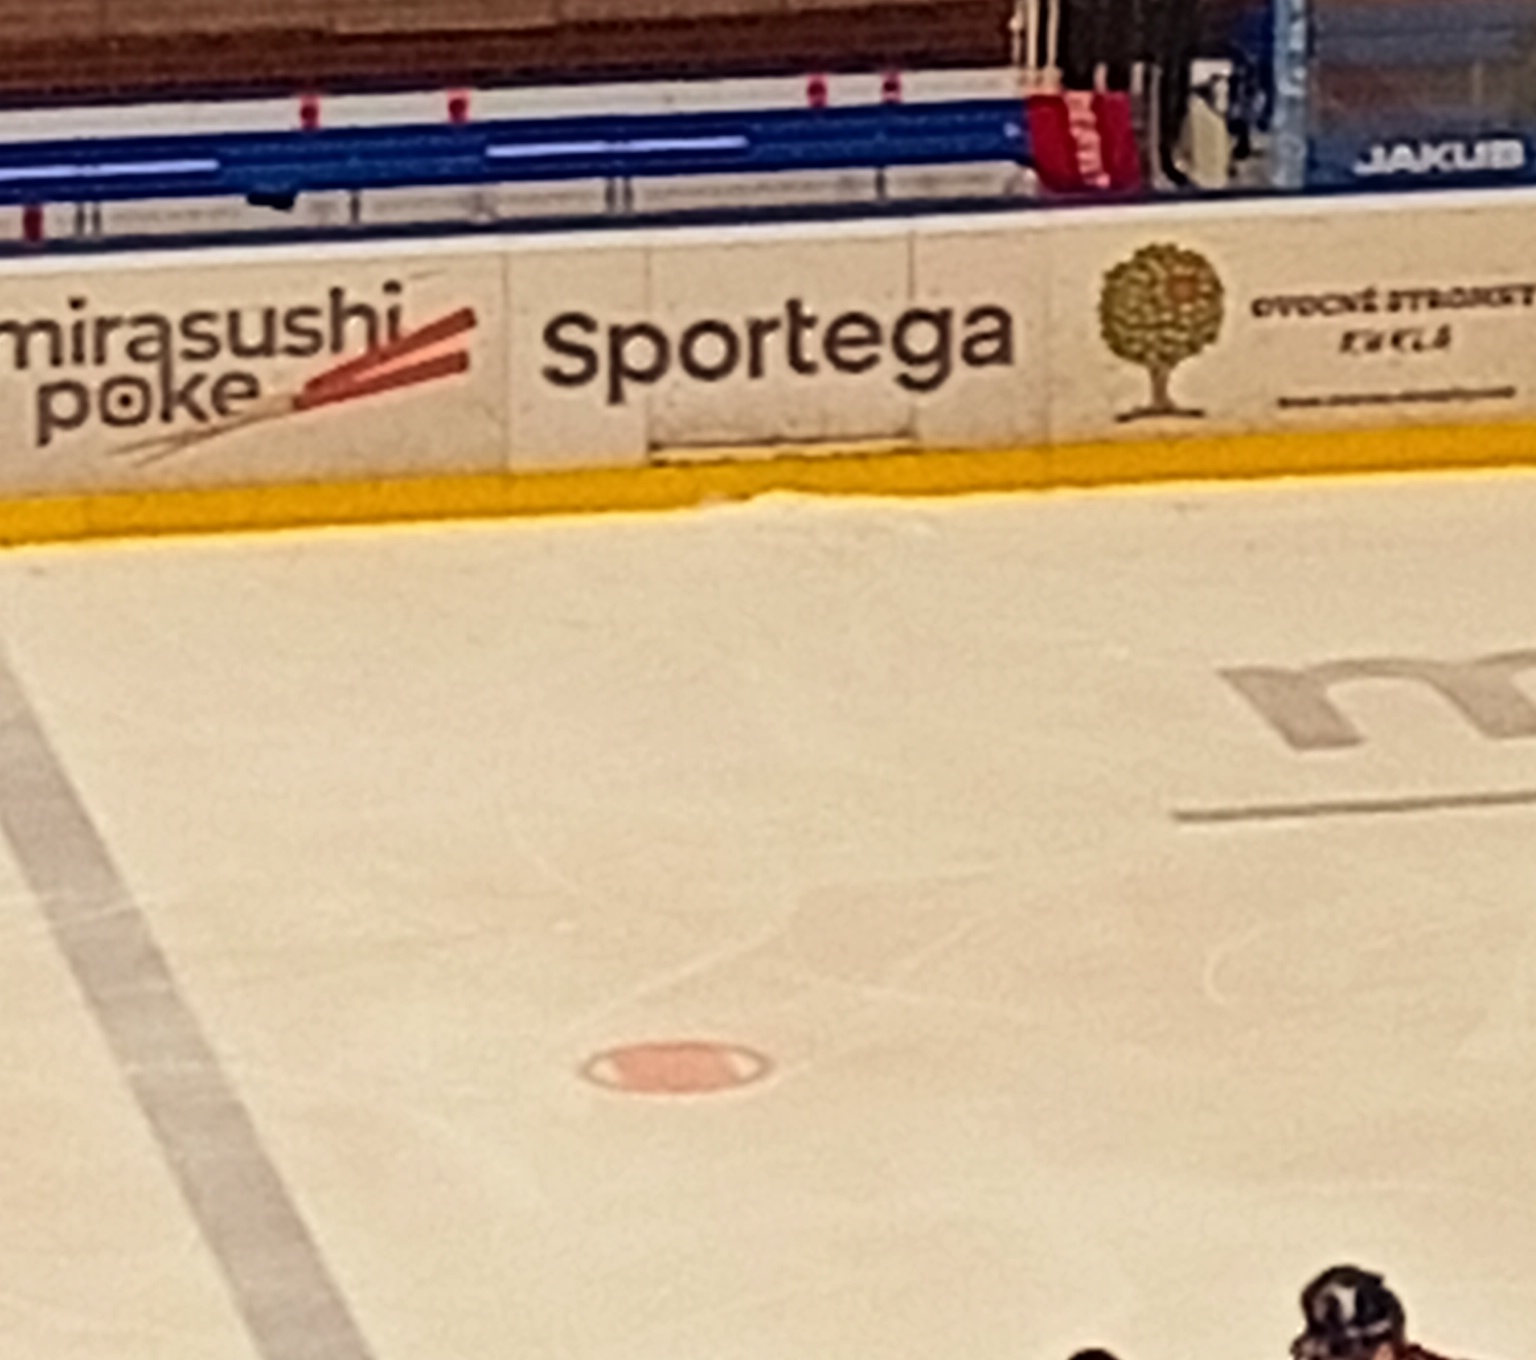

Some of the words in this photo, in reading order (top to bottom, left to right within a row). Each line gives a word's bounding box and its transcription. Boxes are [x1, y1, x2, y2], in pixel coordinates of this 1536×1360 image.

[1353, 139, 1526, 175] JAKUB
[0, 280, 404, 370] mirasushi
[542, 297, 1016, 405] Sportega
[36, 352, 261, 448] poke
